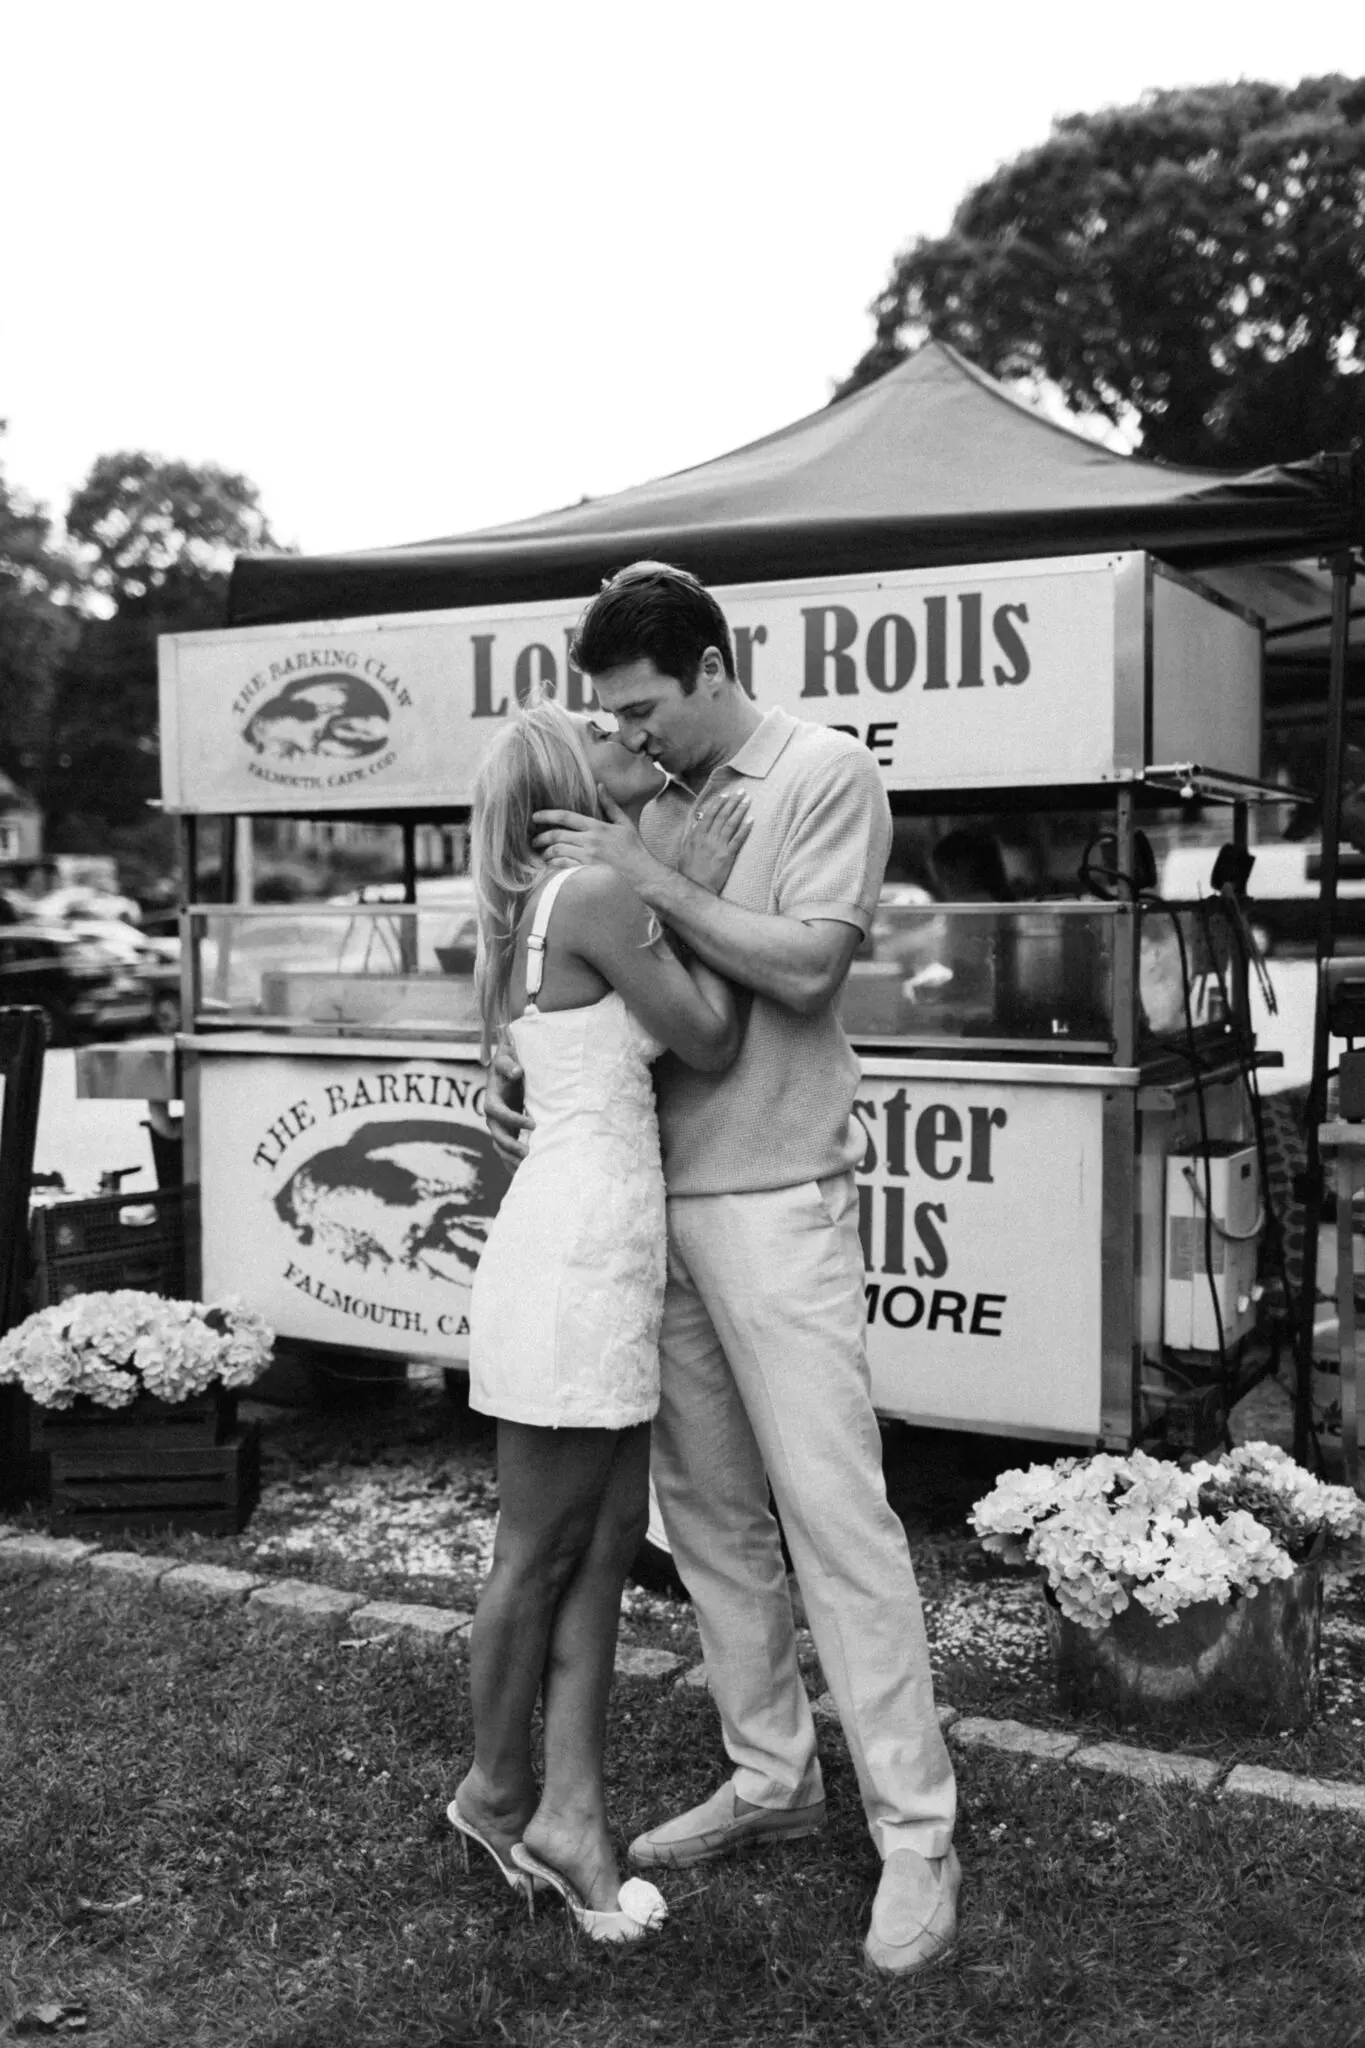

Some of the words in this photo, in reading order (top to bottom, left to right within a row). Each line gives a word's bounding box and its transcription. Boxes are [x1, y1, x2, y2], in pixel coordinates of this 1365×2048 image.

[232, 673, 265, 714] THE
[269, 649, 357, 680] BARKING
[364, 658, 413, 707] CLAW
[470, 625, 767, 719] Lobr
[800, 592, 1031, 698] Rolls
[327, 768, 366, 788] CAPE
[253, 1099, 316, 1173] THE
[852, 1087, 1008, 1184] ster
[857, 1184, 948, 1280] lls
[282, 1260, 428, 1336] FALMOUTH,
[438, 1314, 471, 1337] CA
